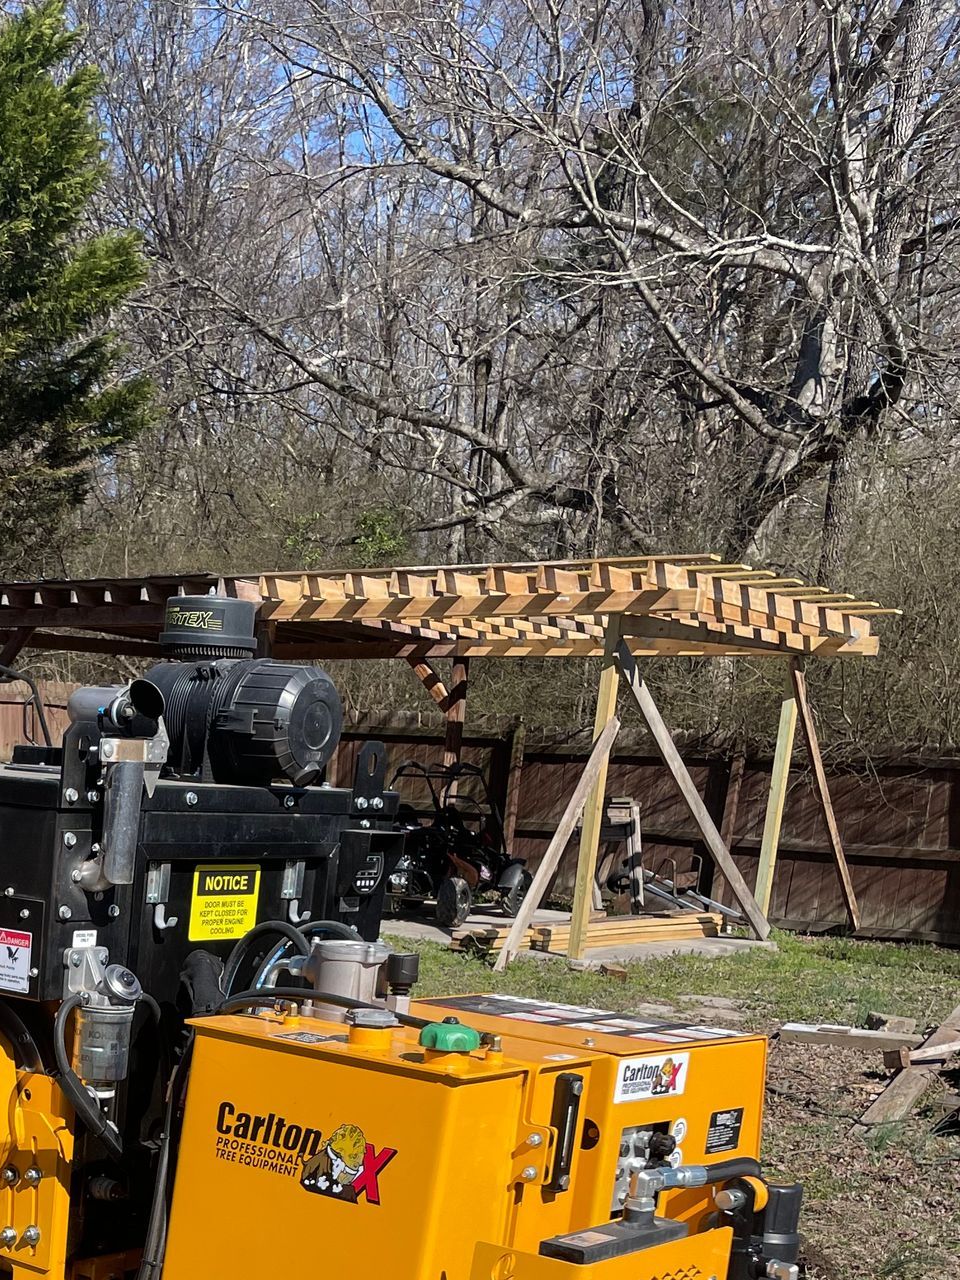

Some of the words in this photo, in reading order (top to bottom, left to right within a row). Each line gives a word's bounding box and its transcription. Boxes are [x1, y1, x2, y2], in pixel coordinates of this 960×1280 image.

[205, 875, 249, 891] NOTICE
[204, 900, 221, 908] DOOR
[221, 900, 236, 908] MUST
[199, 910, 214, 918] KEPT
[214, 909, 236, 917] CLOSED
[237, 908, 248, 916] FOR
[201, 918, 224, 926] PROPER
[224, 917, 244, 925] ENGINE
[210, 927, 234, 935] COOLING
[6, 936, 29, 947] DANGER
[623, 1063, 660, 1082] Carlton
[216, 1101, 323, 1158] Carlton
[216, 1136, 301, 1167] PROFESSIONAL
[215, 1148, 236, 1162] TREE
[238, 1156, 299, 1178] EQUIPMENT
